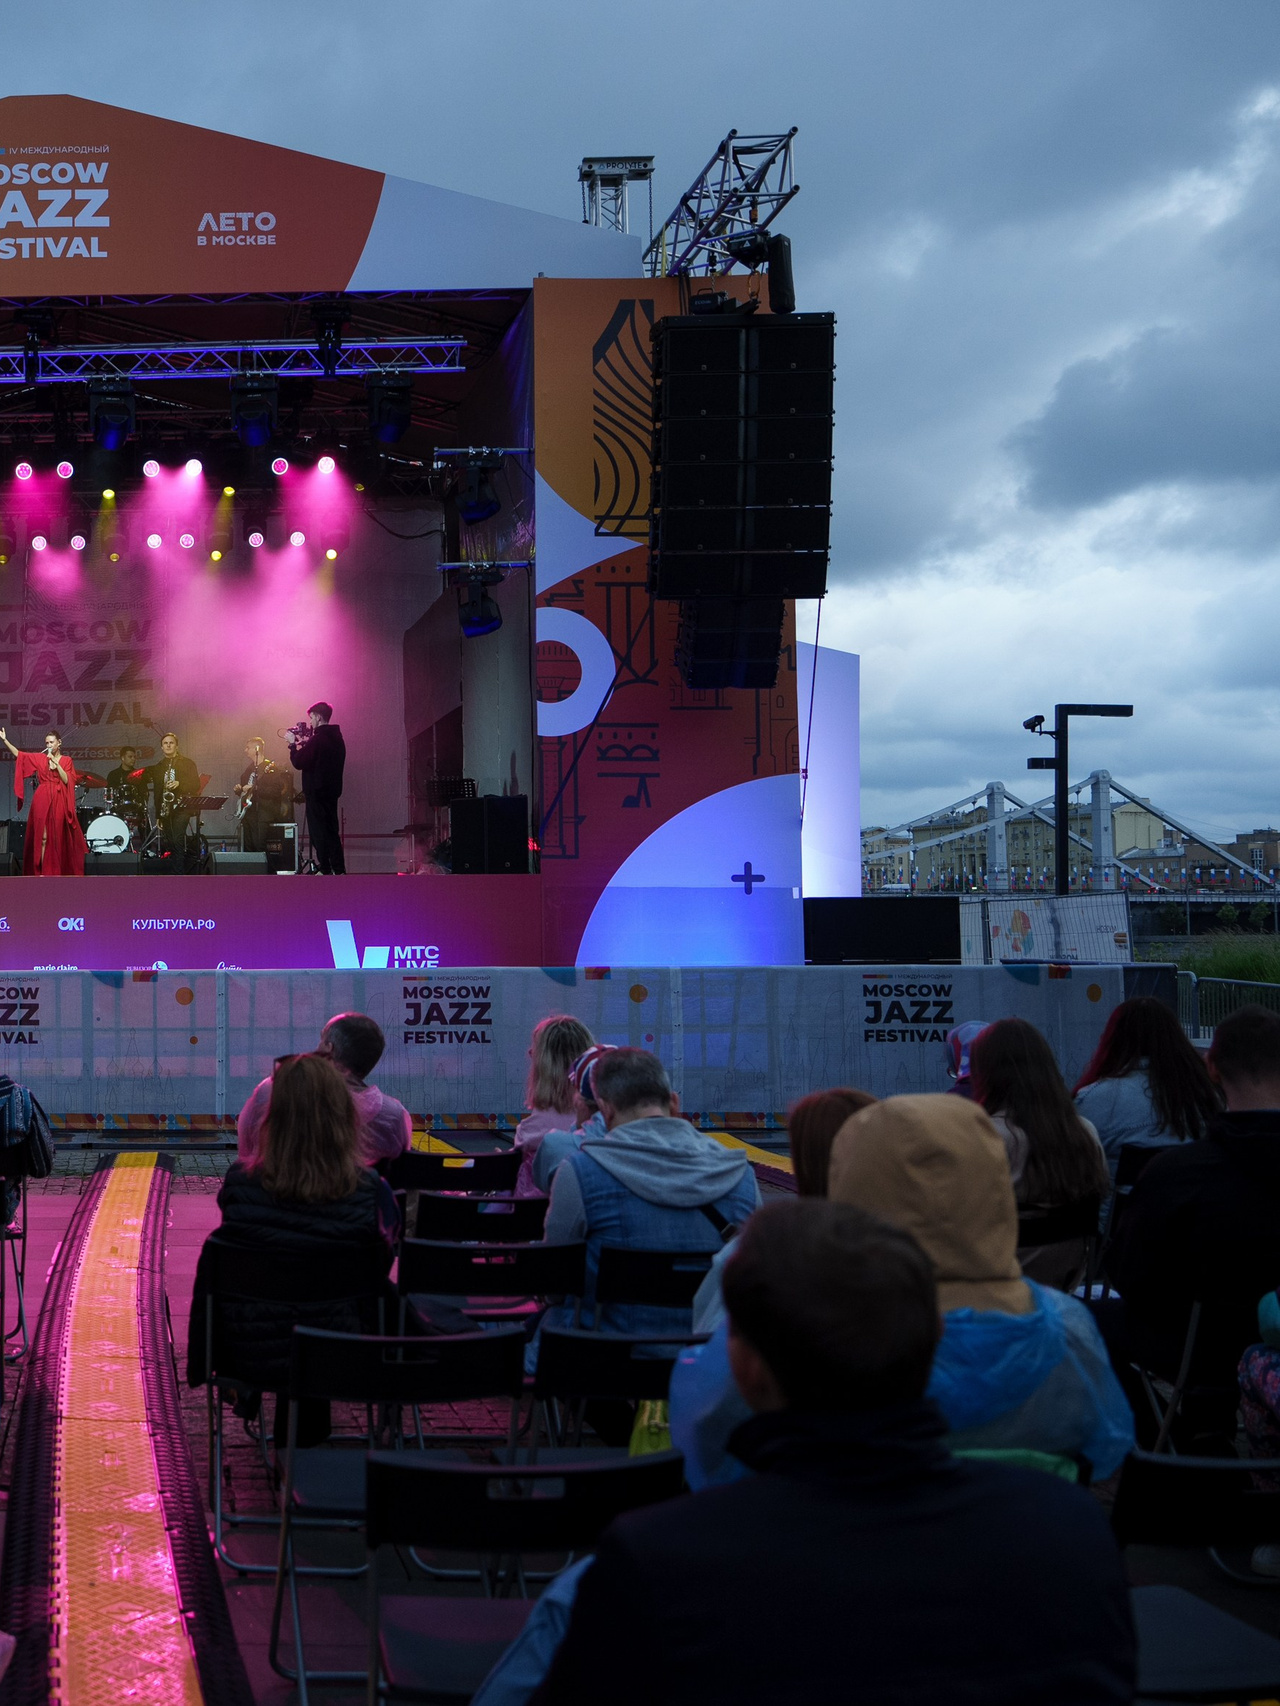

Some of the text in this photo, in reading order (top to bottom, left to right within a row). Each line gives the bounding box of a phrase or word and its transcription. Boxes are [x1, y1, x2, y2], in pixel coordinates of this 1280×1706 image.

[9, 145, 110, 155] IV МЕЖДУНАРОДНЫЙ
[197, 211, 277, 232] ЛЕТО
[196, 234, 277, 246] В МОСКВЕ
[58, 917, 85, 931] OK!
[132, 918, 216, 931] КУЛЬТУРА.РФ
[403, 985, 491, 999] MOSCOW
[862, 984, 952, 997] MOSCOW
[404, 1002, 492, 1026] JAZZ
[864, 1000, 954, 1024] JAZZ
[403, 1030, 491, 1044] FESTIVAL
